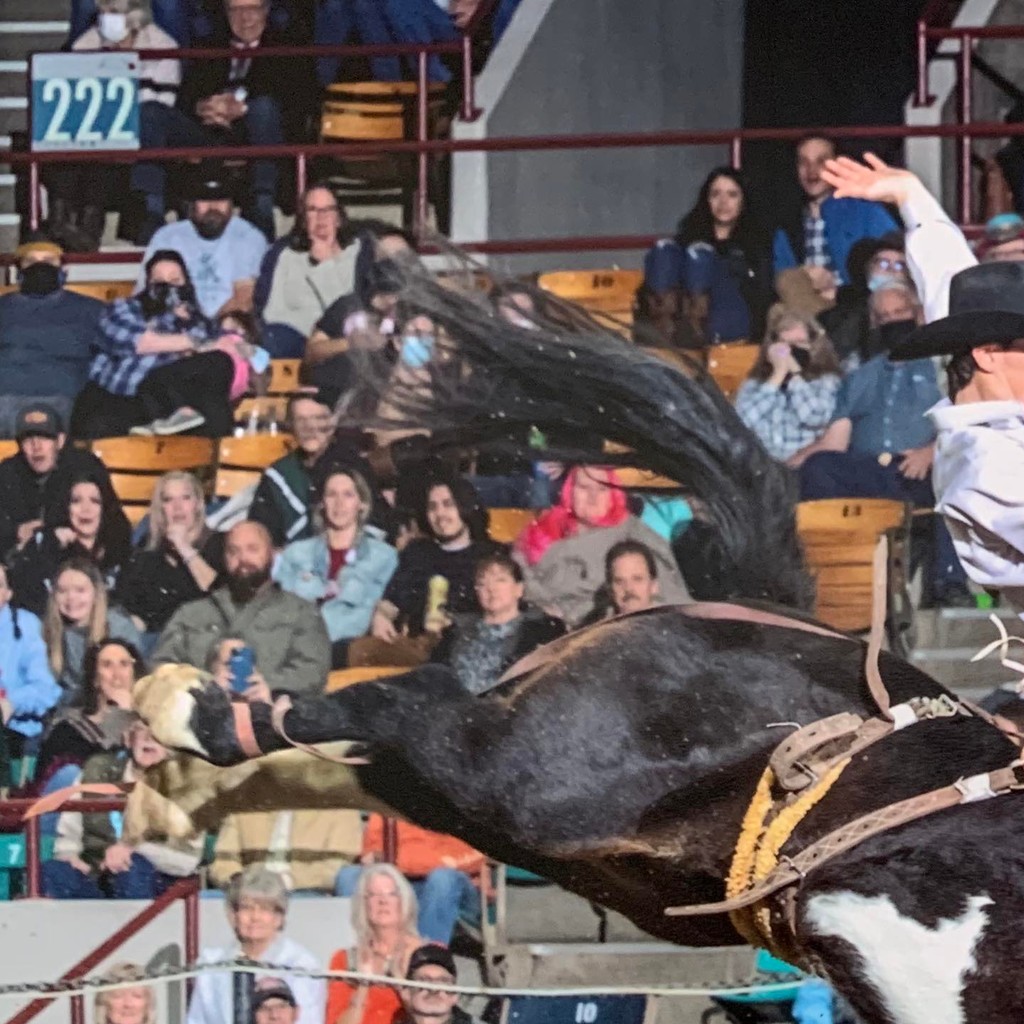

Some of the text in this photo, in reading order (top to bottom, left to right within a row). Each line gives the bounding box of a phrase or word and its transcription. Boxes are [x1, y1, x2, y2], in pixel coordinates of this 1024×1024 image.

[42, 78, 135, 141] 222
[9, 843, 22, 865] 7
[575, 1002, 598, 1024] 10
